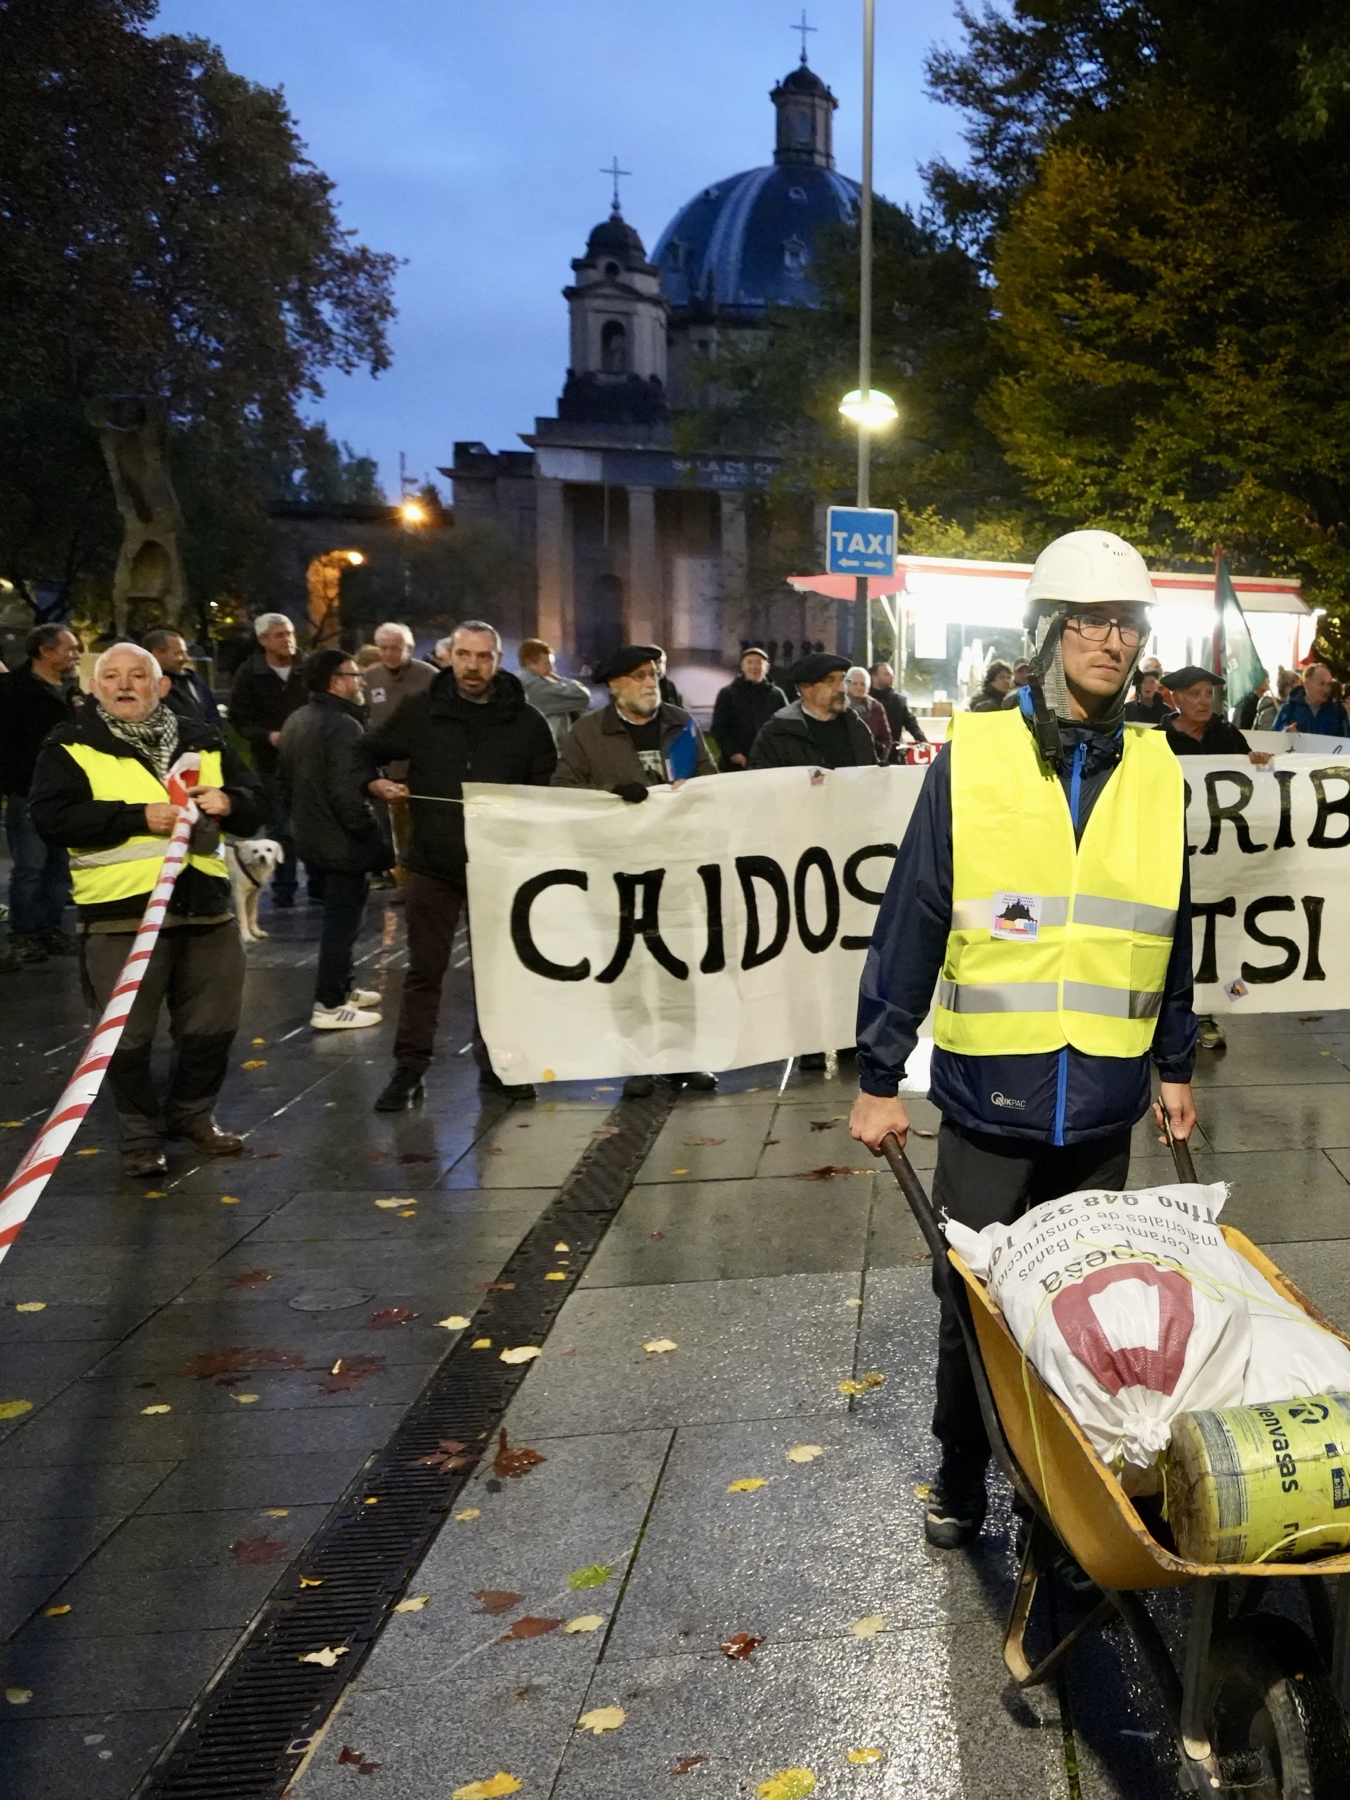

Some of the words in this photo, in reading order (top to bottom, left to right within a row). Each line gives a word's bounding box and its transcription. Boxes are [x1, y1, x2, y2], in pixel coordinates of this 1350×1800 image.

[831, 531, 892, 556] TAXI
[510, 842, 898, 984] CAIDOS
[1083, 1193, 1139, 1207] 948
[1097, 1211, 1120, 1221] de
[1075, 1228, 1086, 1241] y
[1090, 1221, 1190, 1255] Ceramicas
[1126, 1213, 1219, 1247] materiales
